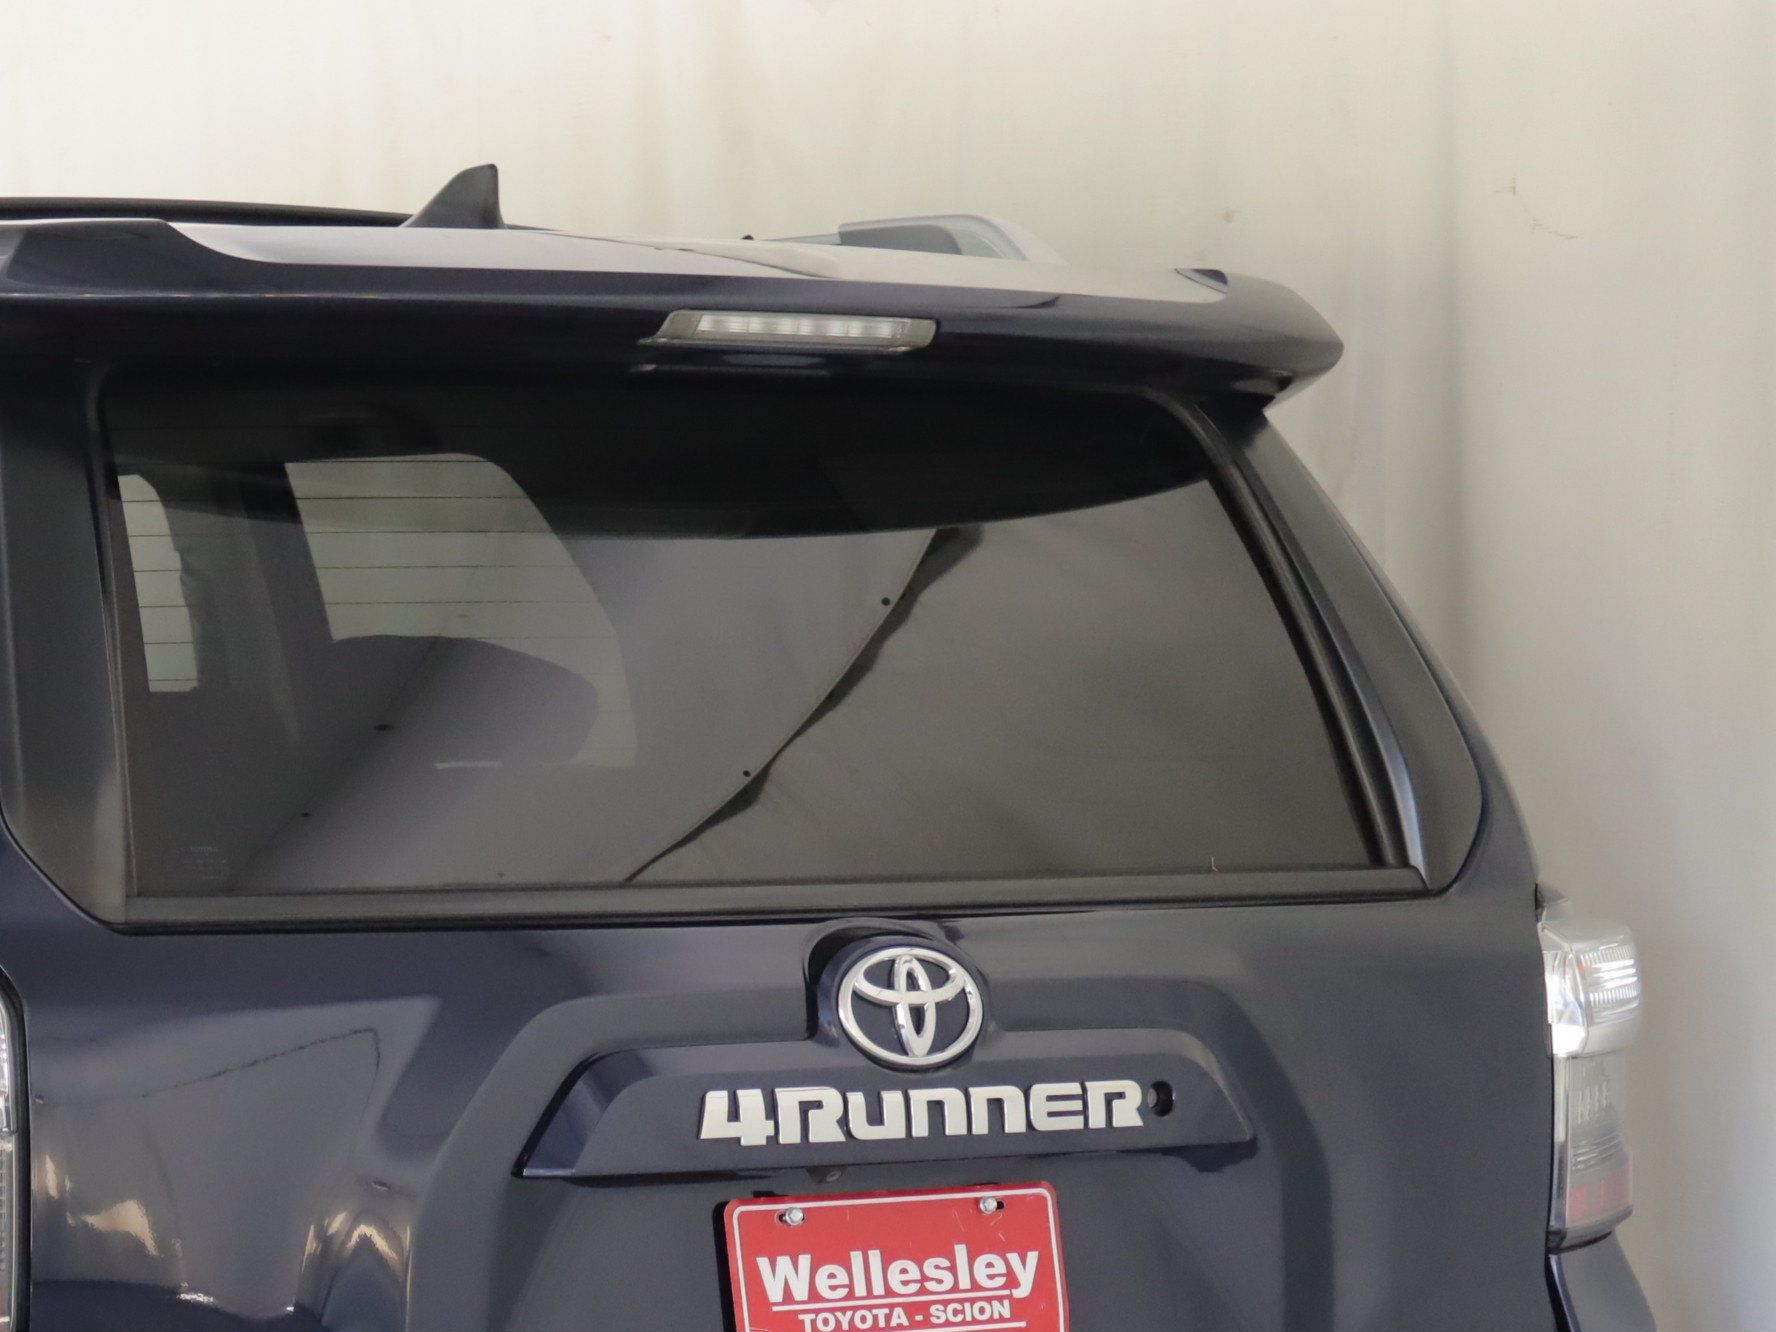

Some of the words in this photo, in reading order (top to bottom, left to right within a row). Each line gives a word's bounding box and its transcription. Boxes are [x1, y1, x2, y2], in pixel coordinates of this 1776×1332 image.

[700, 1079, 1145, 1146] 4RUNNER
[756, 1244, 1040, 1303] Wellesley
[929, 1300, 1012, 1324] SCION
